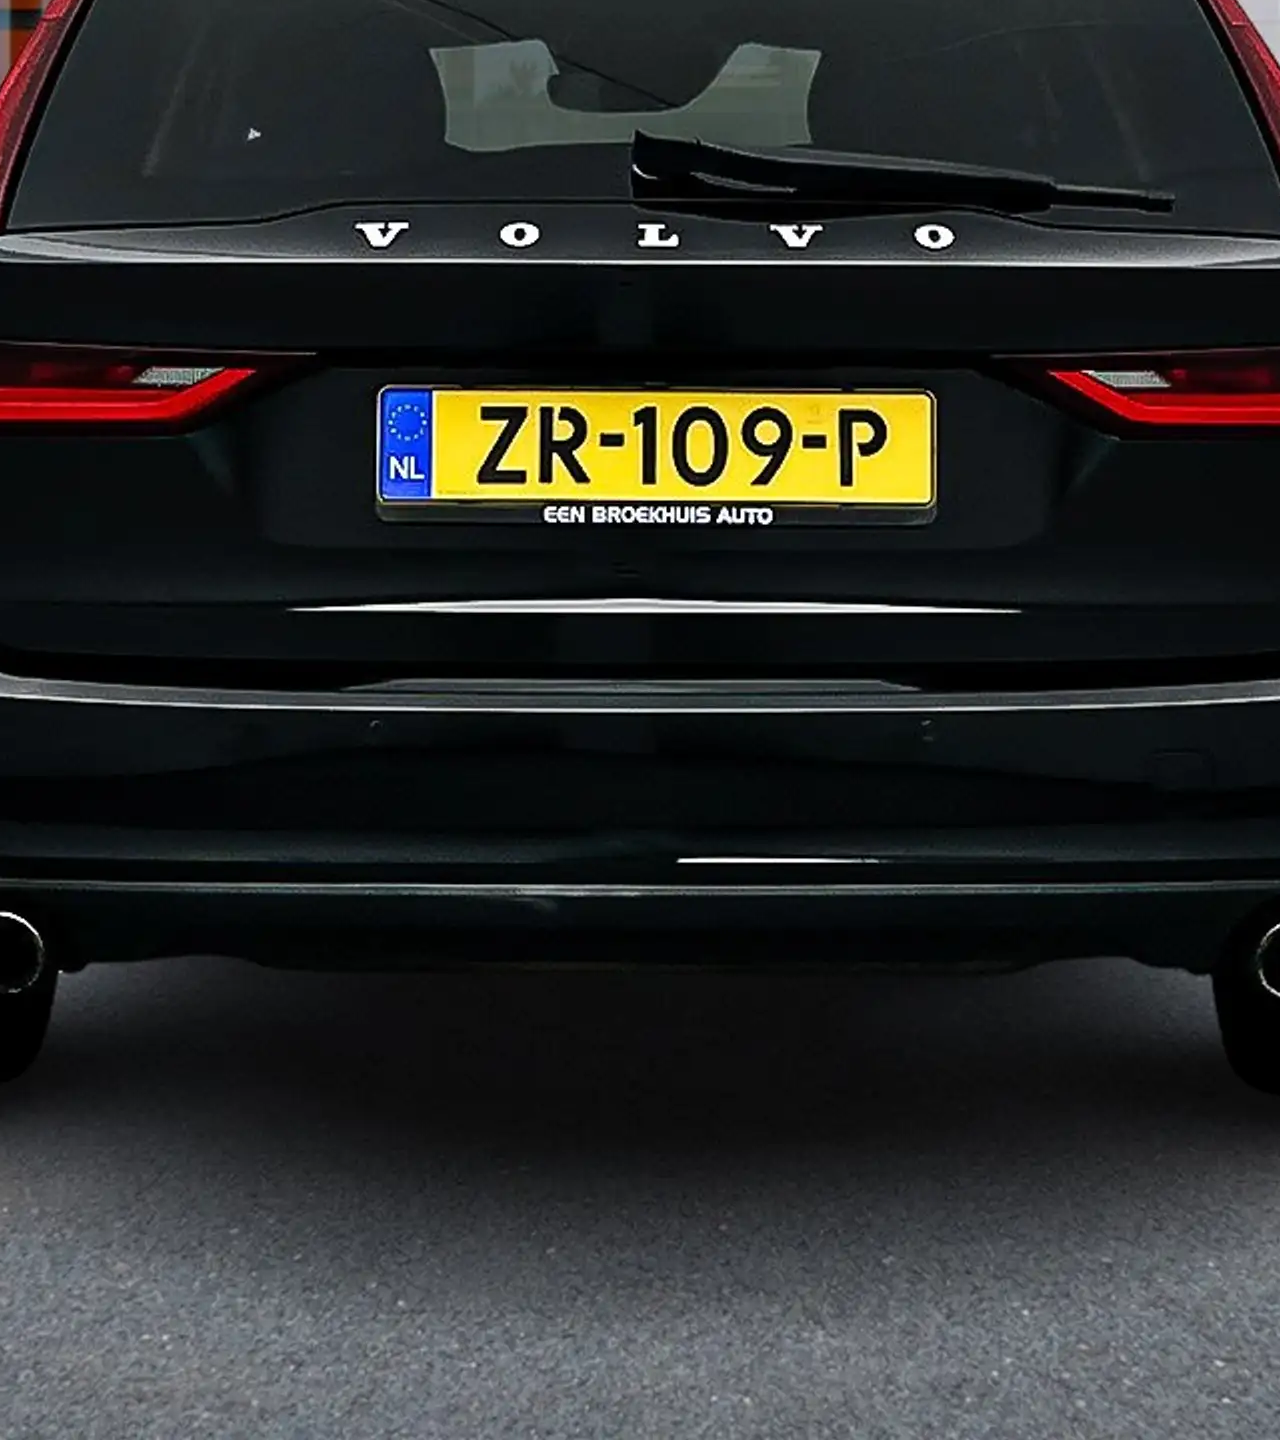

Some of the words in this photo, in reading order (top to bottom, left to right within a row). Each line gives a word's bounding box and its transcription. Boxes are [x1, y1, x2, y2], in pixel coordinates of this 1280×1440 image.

[354, 221, 956, 250] VOLVO
[476, 405, 888, 488] ZR-109-P
[389, 455, 426, 480] NL
[543, 505, 586, 524] EEN
[591, 505, 712, 525] BROEKHUIS
[715, 506, 775, 526] AUTO
